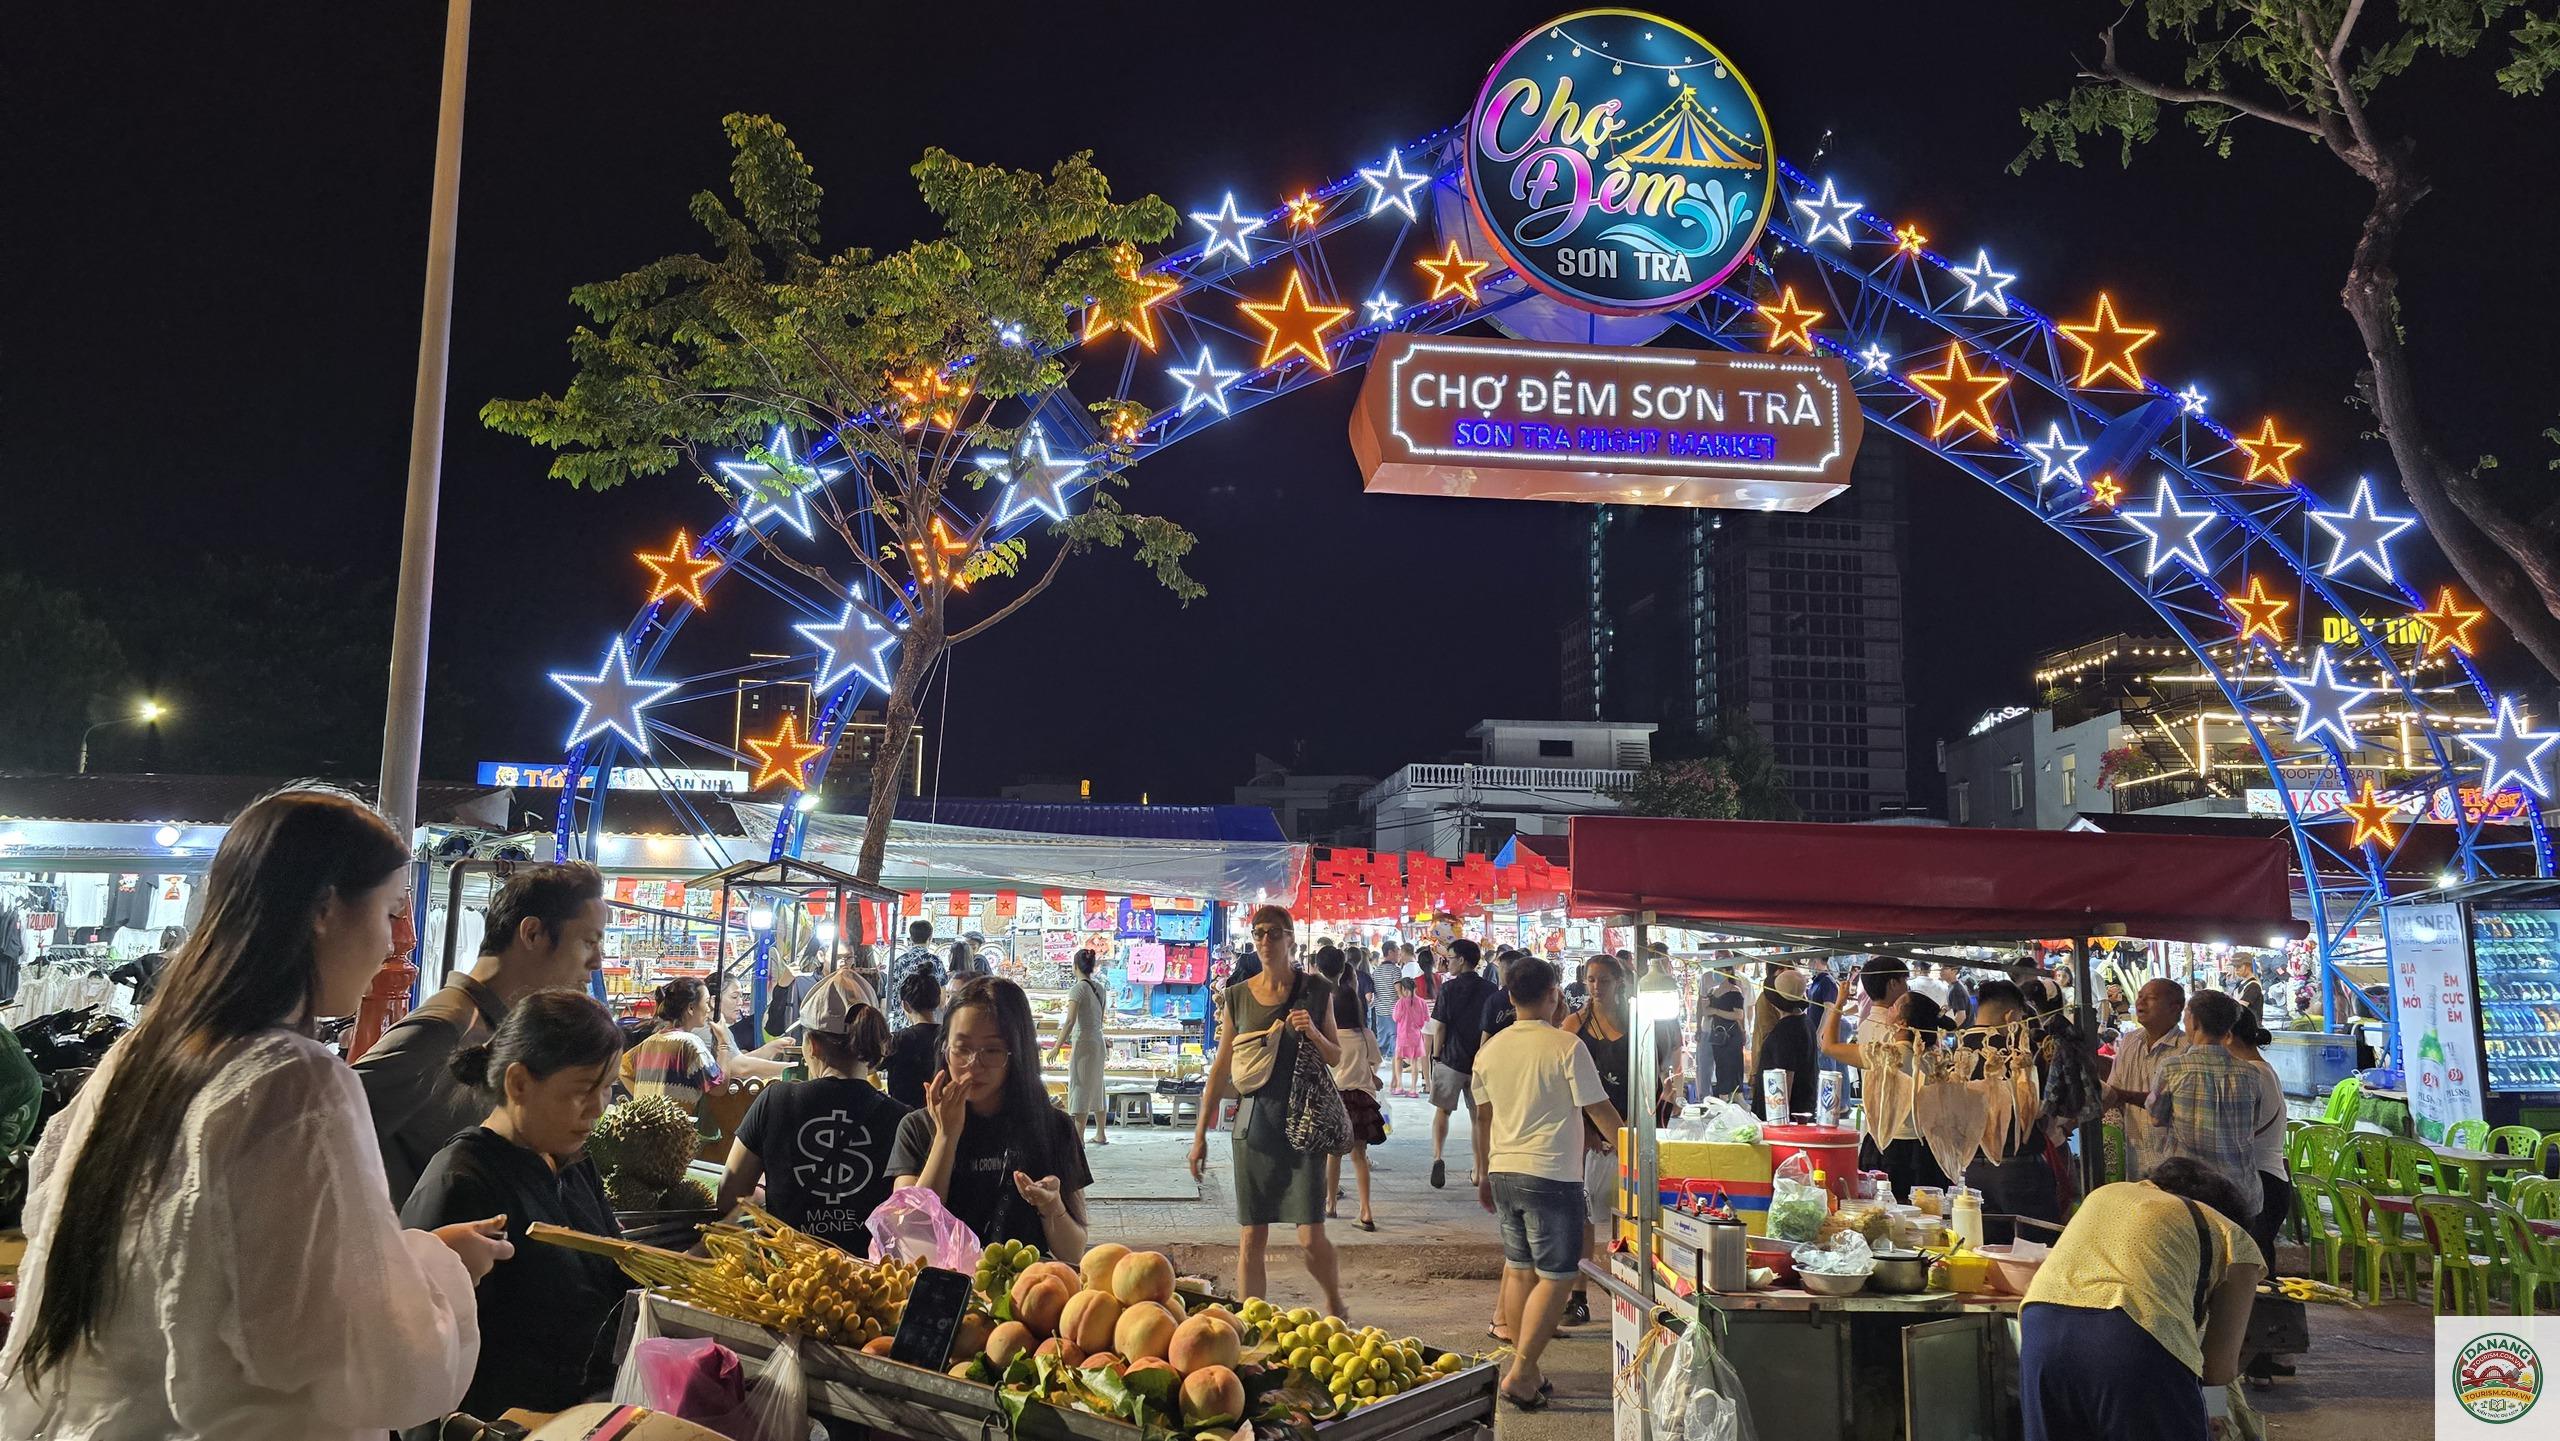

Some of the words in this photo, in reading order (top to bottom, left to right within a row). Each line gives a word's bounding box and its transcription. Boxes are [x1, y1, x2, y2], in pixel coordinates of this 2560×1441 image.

[1479, 76, 1626, 163] Chợ
[1509, 146, 1686, 247] Đêm
[1557, 247, 1619, 279] SƠN
[1633, 250, 1692, 283] TRÀ
[1410, 372, 1509, 419] CHỢ
[1517, 370, 1617, 417] ĐÊM
[1631, 383, 1725, 422] SƠN
[1738, 383, 1822, 427] TRÀ
[1578, 429, 1660, 454] NIGHT
[1669, 433, 1776, 460] MARKET
[523, 767, 594, 789] Tigr
[2349, 769, 2376, 781] BAR
[2393, 914, 2457, 931] PISNER
[2400, 963, 2417, 974] BIA
[2443, 972, 2459, 986] ÊM
[2447, 1007, 2463, 1023] ÊM
[806, 1208, 857, 1222] MADE
[801, 1219, 866, 1235] MONEY
